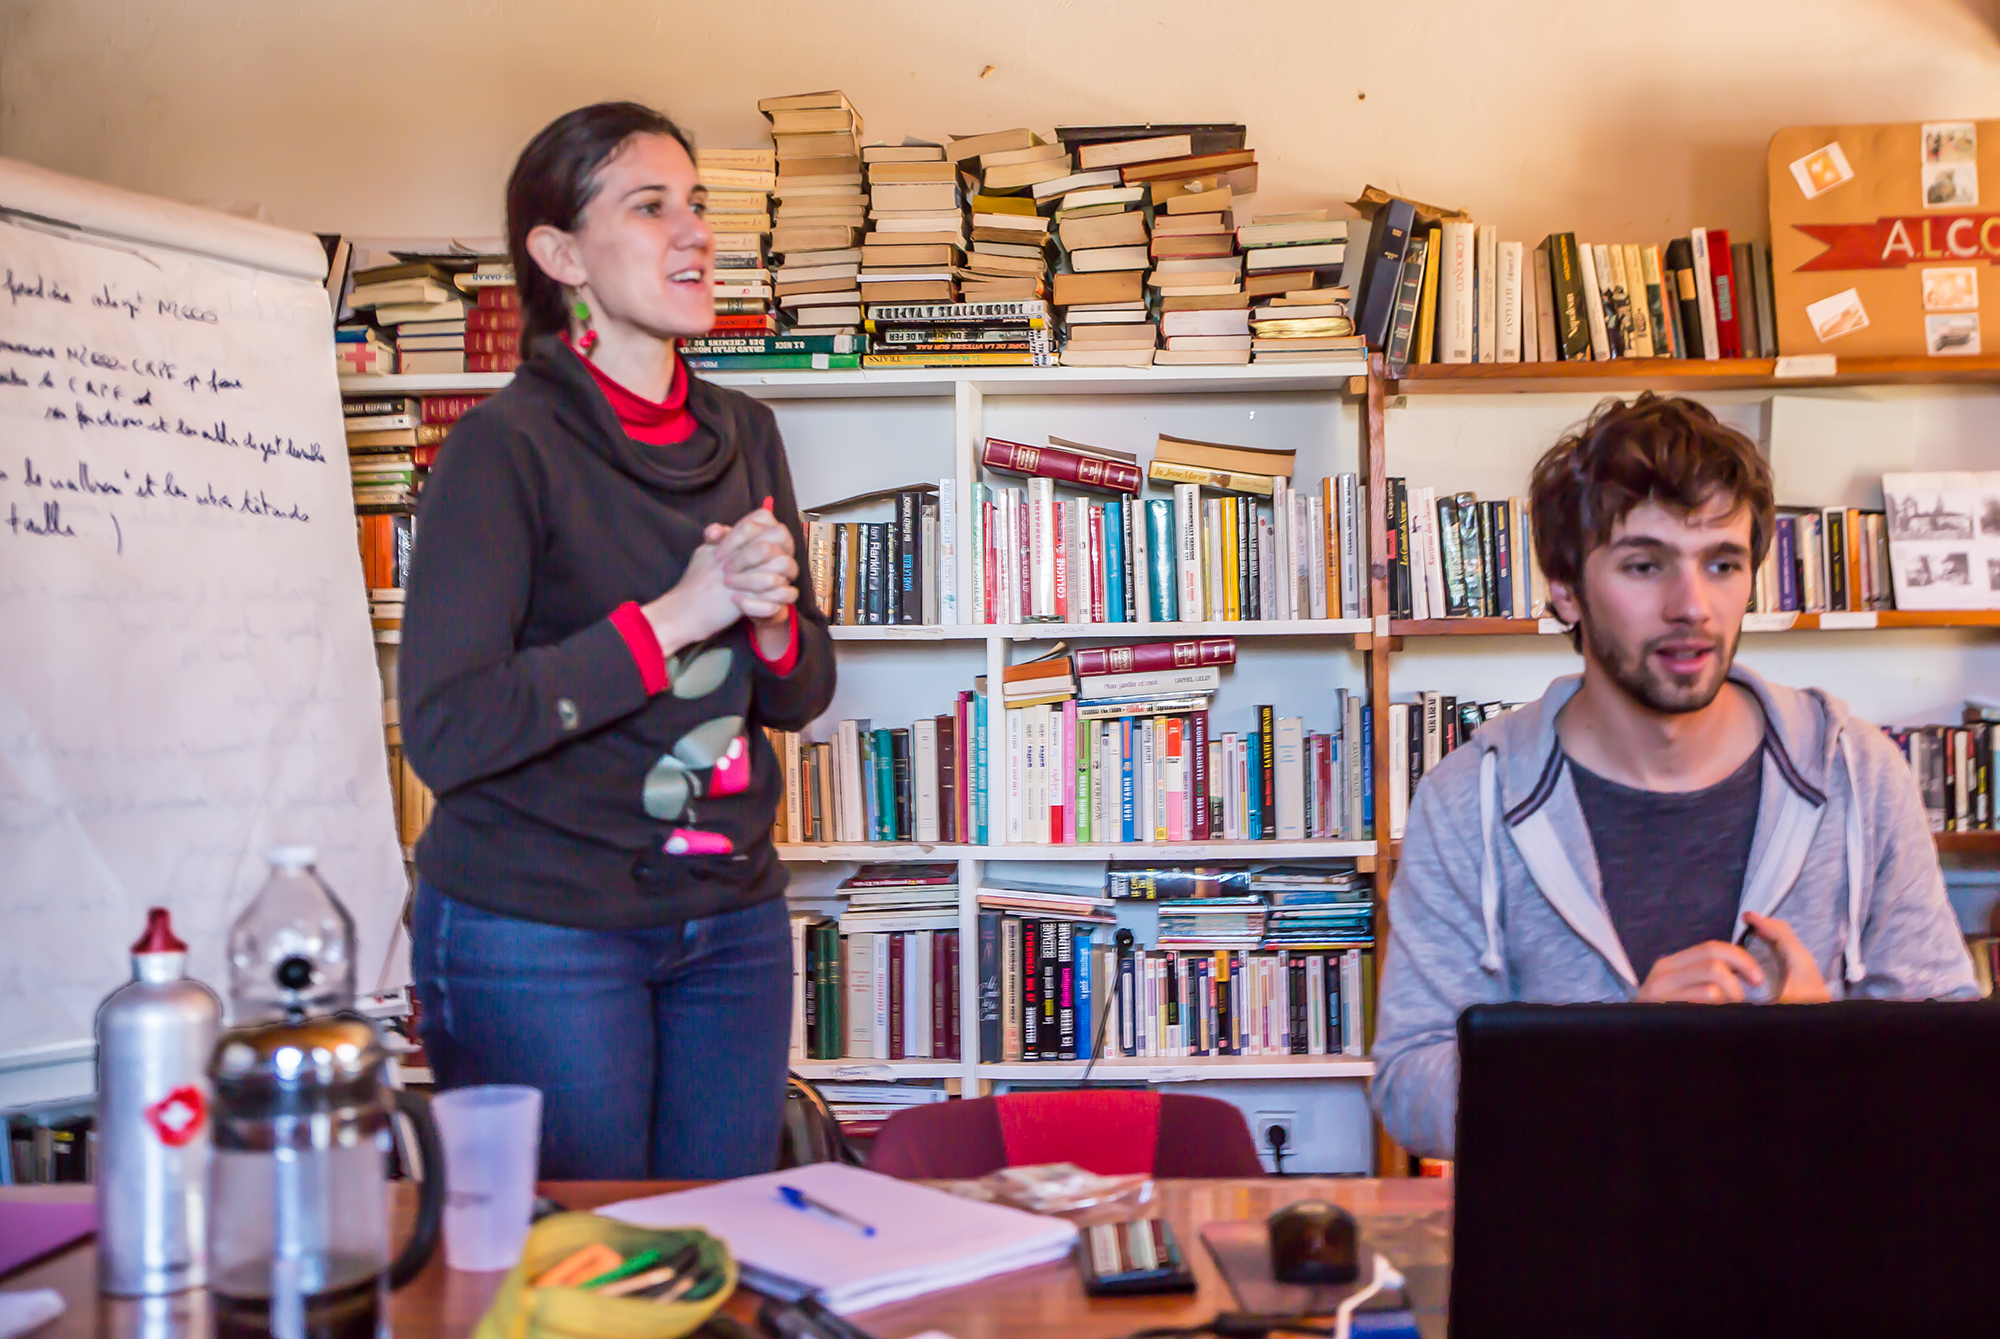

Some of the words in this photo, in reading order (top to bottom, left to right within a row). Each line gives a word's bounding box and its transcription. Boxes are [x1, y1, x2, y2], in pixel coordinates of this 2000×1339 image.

[1505, 286, 1514, 335] CASTELOT
[707, 338, 746, 346] CHEMINS
[749, 338, 765, 346] DES
[888, 332, 904, 341] FER
[905, 332, 916, 341] DE
[711, 345, 736, 353] ATLAS
[737, 345, 766, 353] GRAND
[934, 343, 949, 351] SUR
[950, 343, 983, 351] VITESSE
[984, 343, 995, 351] LA
[996, 343, 1006, 351] DE
[868, 355, 901, 363] TRAINS
[869, 526, 881, 539] Ian
[1187, 537, 1195, 560] DOSSIERS
[869, 541, 881, 577] Rankin
[1056, 558, 1065, 598] COLUCHE
[1263, 707, 1272, 732] RENARD
[978, 727, 986, 748] enfant
[1195, 726, 1204, 745] GUIDE
[1263, 734, 1272, 742] DU
[978, 751, 986, 763] son
[1263, 743, 1272, 758] NUIT
[978, 767, 986, 789] sauver
[1078, 776, 1087, 796] MEYER
[1123, 777, 1132, 800] YANNE
[978, 792, 986, 825] Comment
[1195, 797, 1204, 809] DES
[1078, 799, 1087, 827] PHILIPPE
[1123, 804, 1132, 821] JEAN
[1195, 809, 1204, 826] VINS
[1041, 923, 1057, 958] BELLEMARE
[1058, 923, 1071, 962] BELLEMARE
[1025, 932, 1036, 975] VENGERAI
[1025, 977, 1036, 990] ME
[1025, 993, 1036, 1002] JE
[1025, 1007, 1036, 1043] BELLEMARE
[1060, 1009, 1073, 1035] TUEURS
